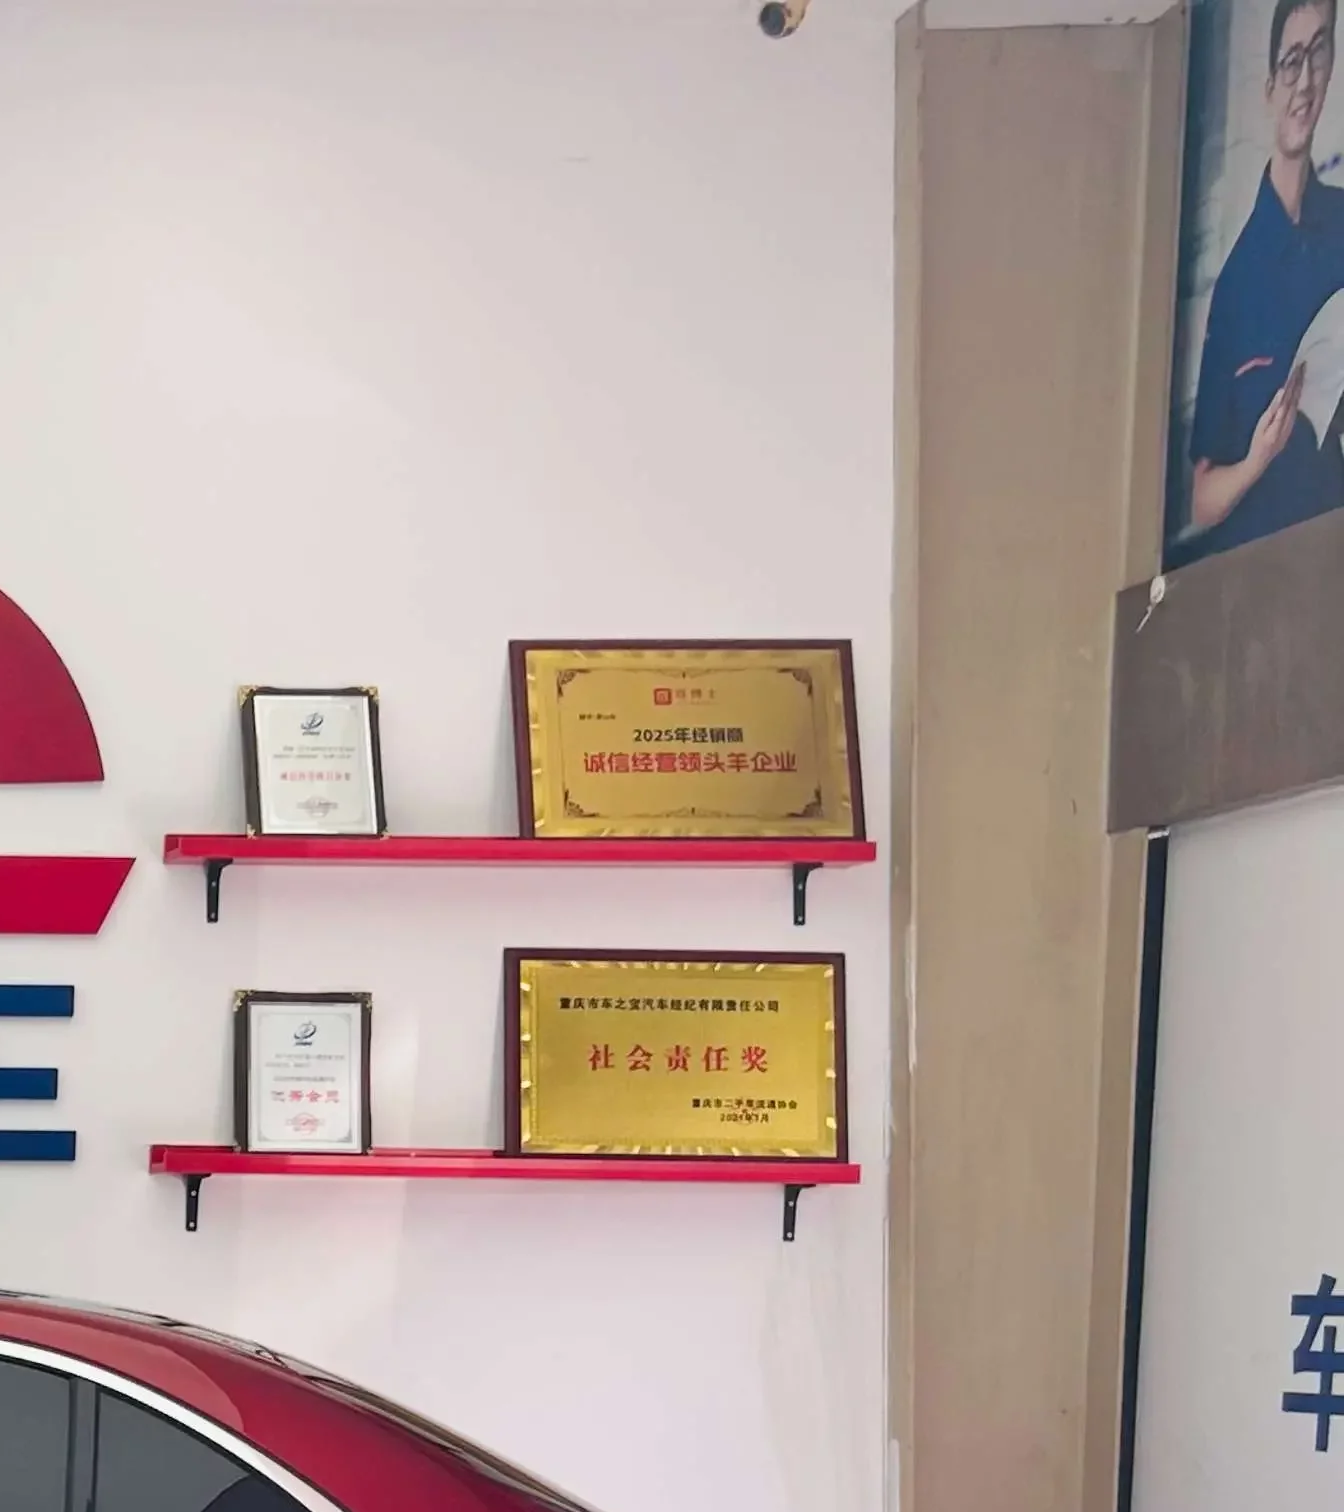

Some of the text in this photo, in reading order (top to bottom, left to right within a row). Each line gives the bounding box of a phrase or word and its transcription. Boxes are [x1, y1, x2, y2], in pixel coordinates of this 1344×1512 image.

[584, 751, 798, 774] 诚信经营领头羊企业
[559, 997, 780, 1014] 重庆市车之宝汽车经纪有限责任公司
[588, 1043, 769, 1074] 社会责任奖
